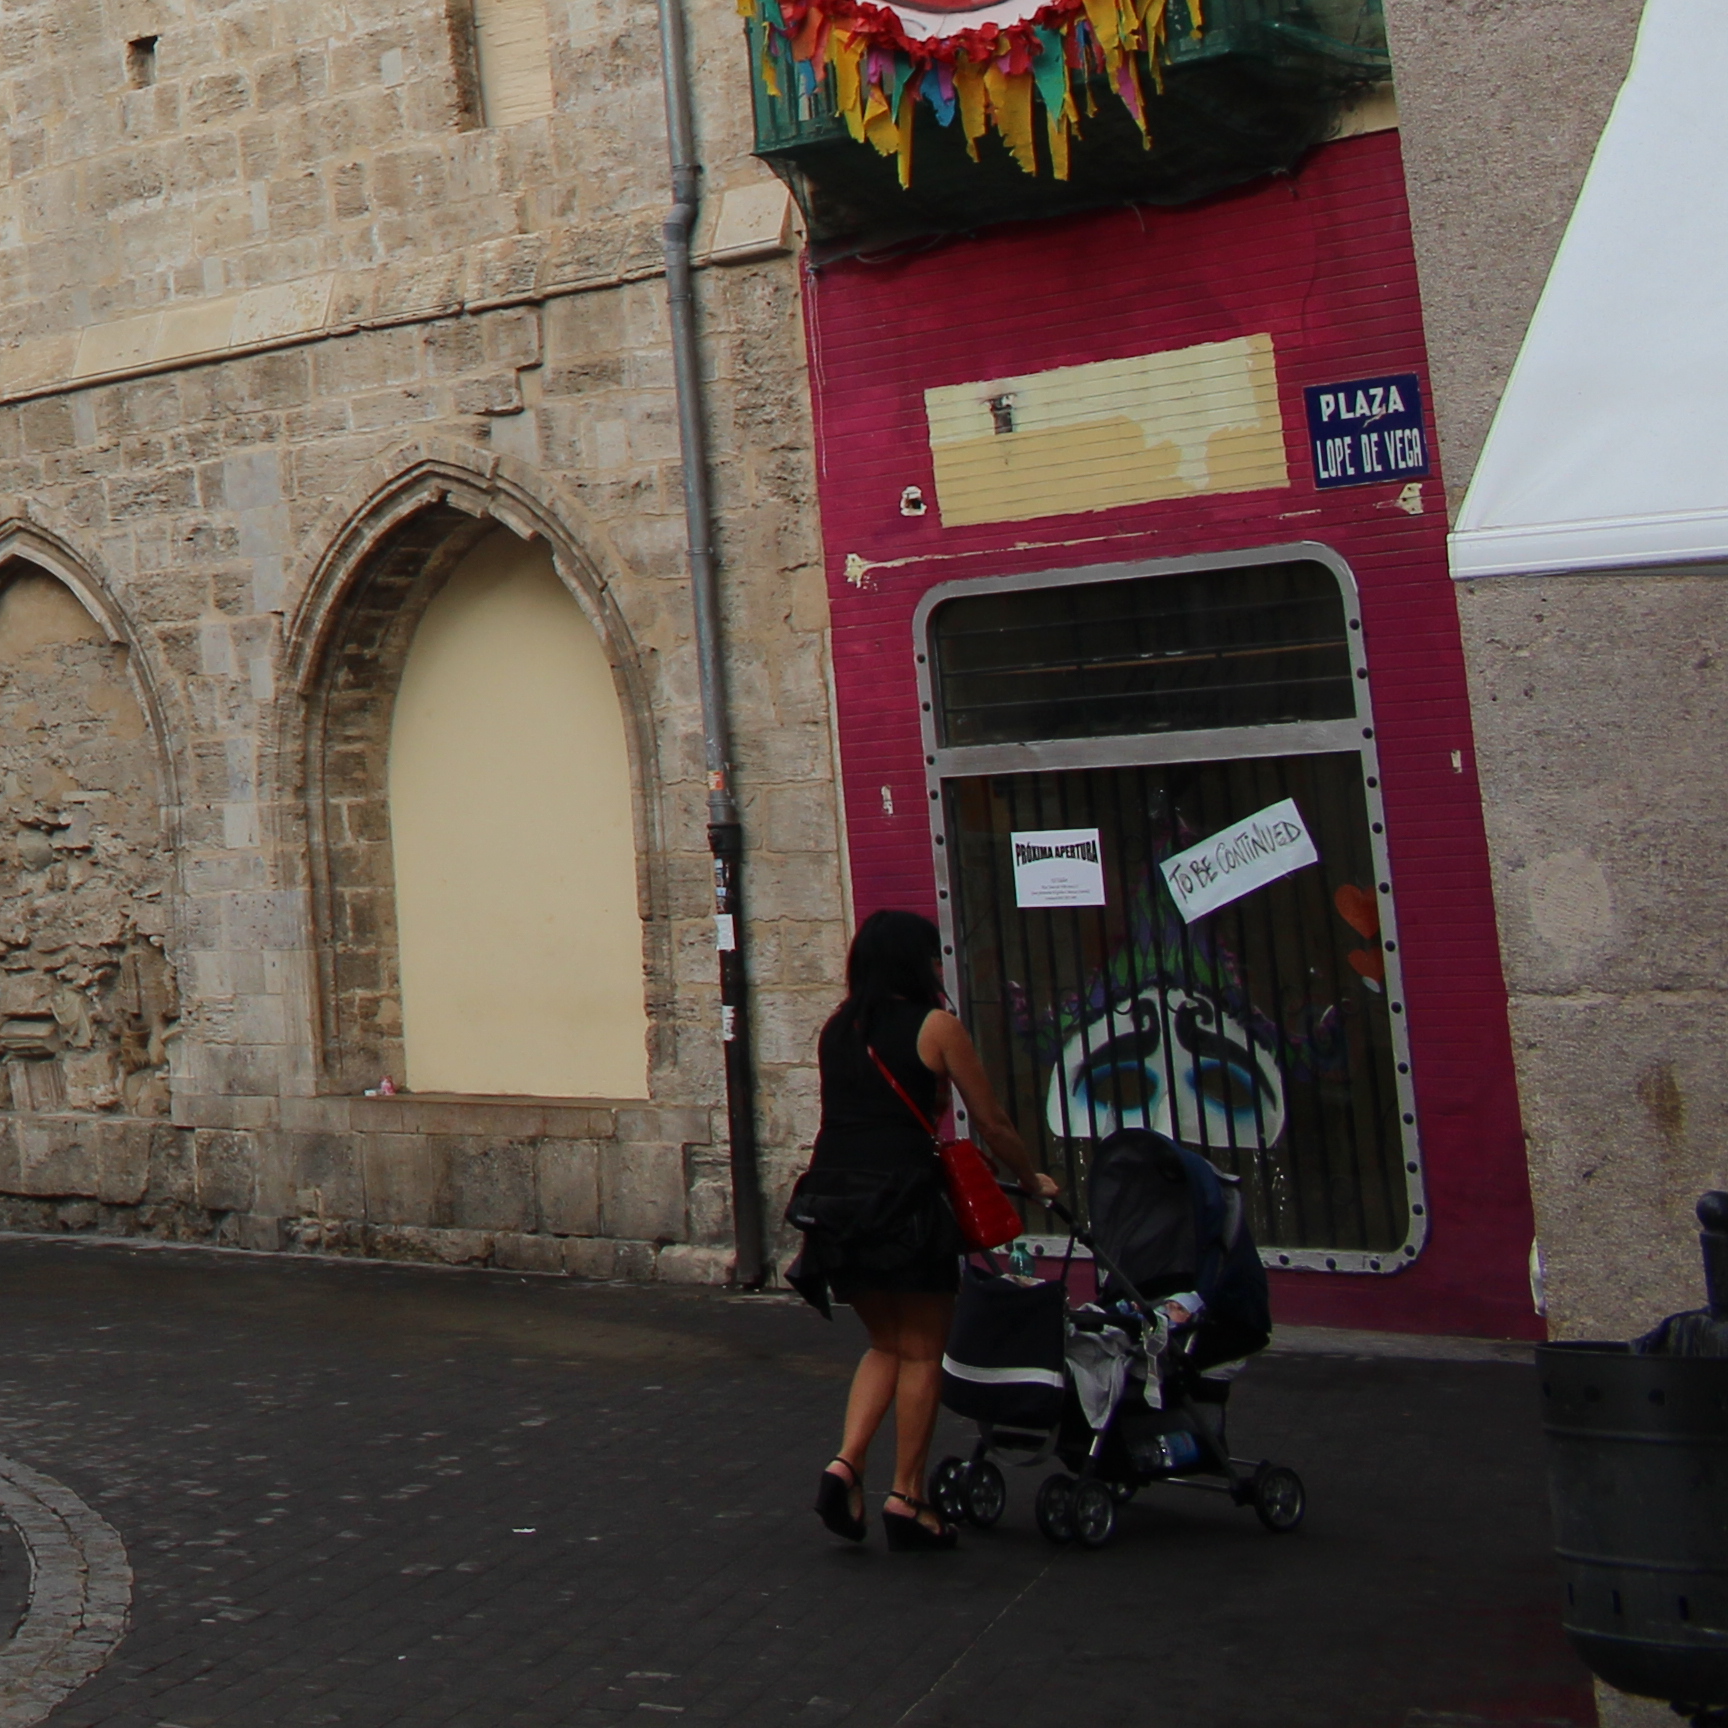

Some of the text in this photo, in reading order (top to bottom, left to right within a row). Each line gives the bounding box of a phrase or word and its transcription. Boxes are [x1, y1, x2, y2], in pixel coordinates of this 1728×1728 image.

[1319, 385, 1405, 421] PLAZA
[1316, 428, 1423, 479] LOPE DE VEGA
[1015, 839, 1099, 867] PRÓXIMA APERTURA
[1168, 863, 1194, 903] TO
[1190, 854, 1218, 888] BE
